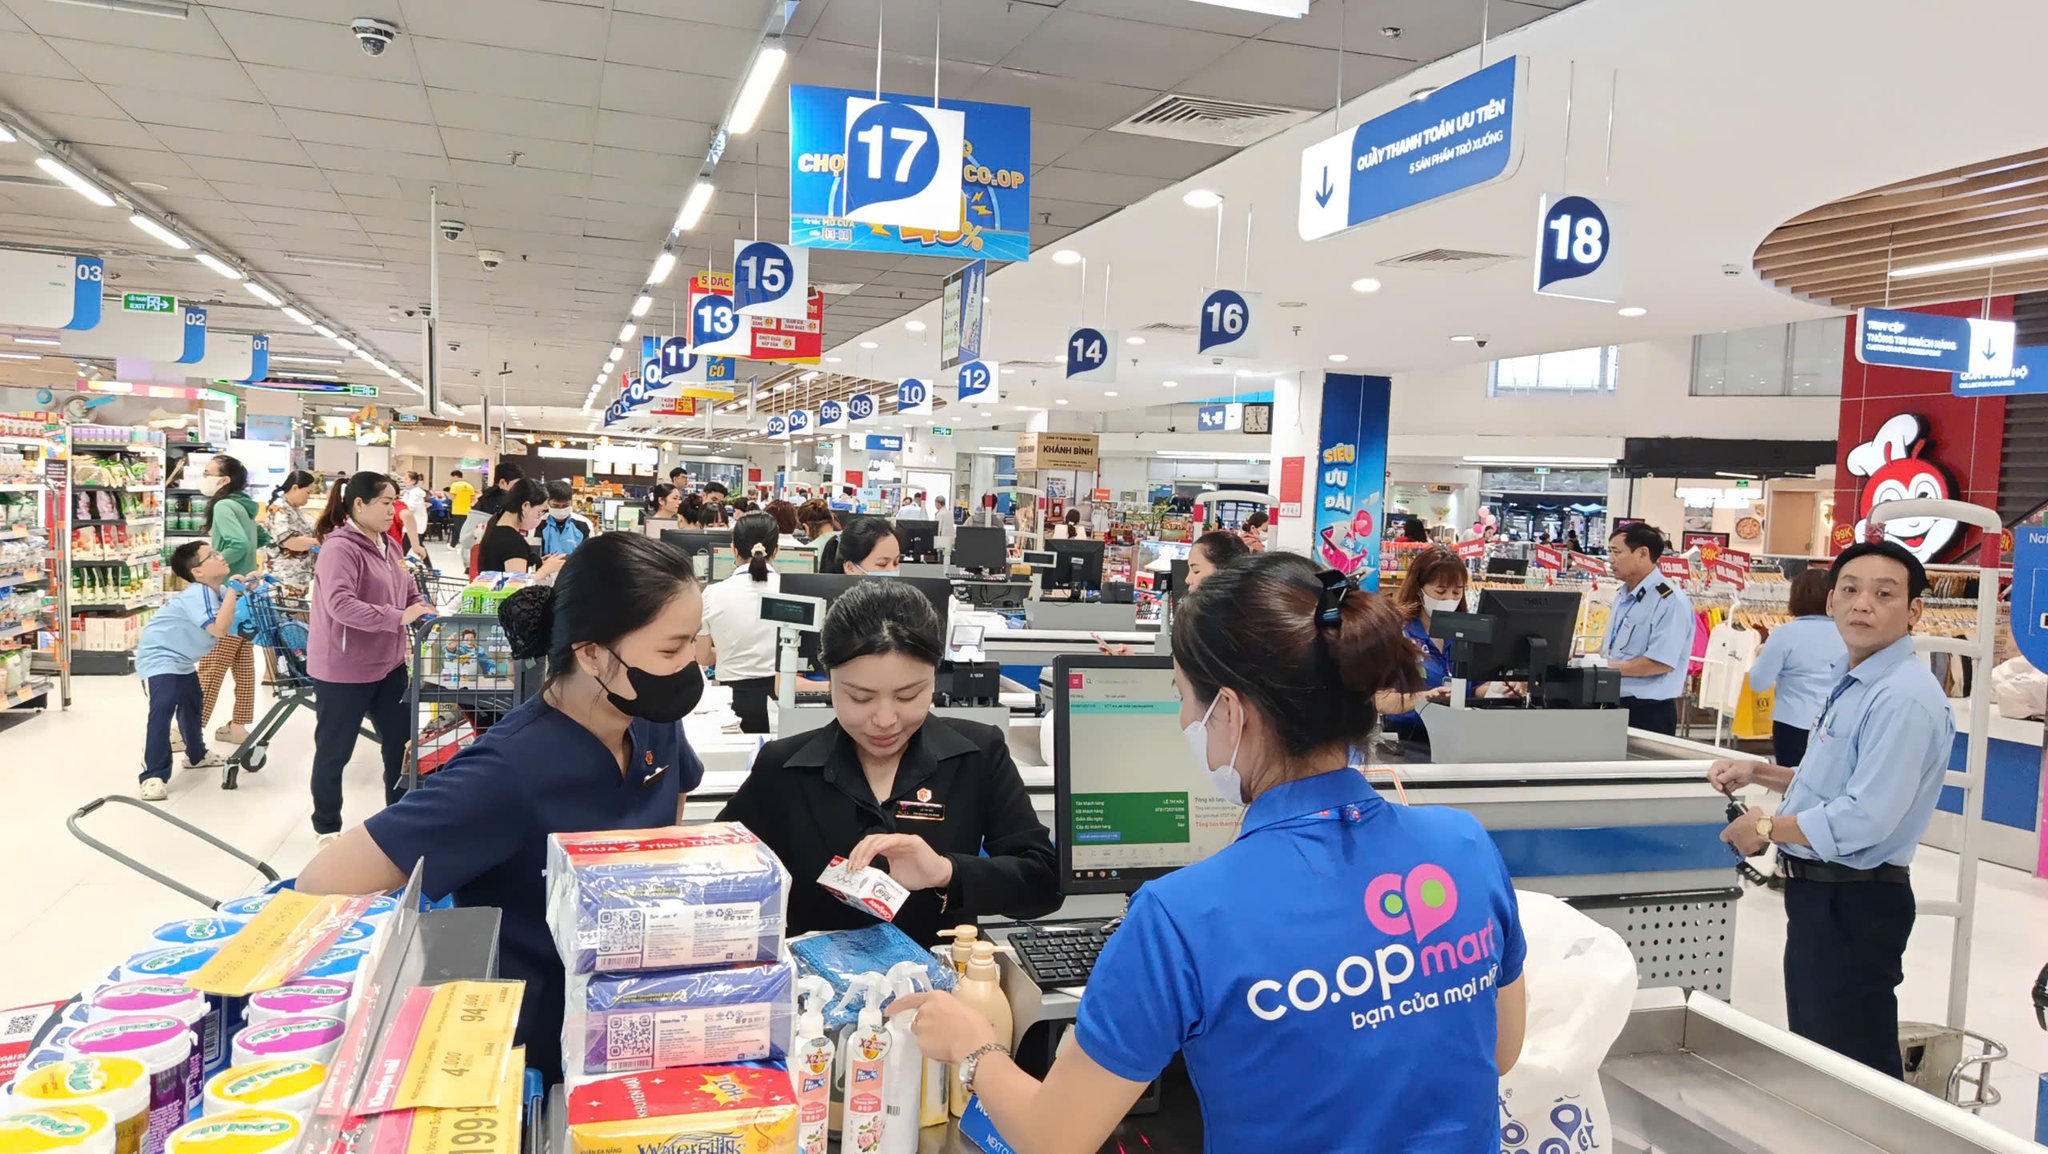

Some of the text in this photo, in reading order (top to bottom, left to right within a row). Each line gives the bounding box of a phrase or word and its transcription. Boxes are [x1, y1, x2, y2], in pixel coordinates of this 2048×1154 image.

[1356, 98, 1506, 172] QUẦY THANH TOÁN ƯU TIÊN
[857, 123, 928, 183] 17
[1408, 162, 1416, 175] 5
[1472, 128, 1504, 152] XUỐNG
[963, 164, 1025, 189] CO.OP
[1549, 215, 1603, 265] 18
[76, 264, 102, 282] 03
[701, 275, 708, 286] 5
[739, 256, 786, 293] 15
[185, 312, 206, 326] 02
[697, 305, 734, 335] 13
[1206, 303, 1244, 336] 16
[253, 339, 268, 351] 01
[1071, 340, 1103, 363] 14
[664, 344, 692, 368] 11
[645, 364, 661, 384] 0
[708, 362, 726, 378] CÓ
[961, 370, 987, 390] 12
[901, 385, 923, 402] 10
[852, 399, 871, 417] 08
[768, 419, 784, 433] 02
[789, 413, 807, 428] 04
[1043, 444, 1072, 455] KHÁNH
[1073, 445, 1093, 456] BÌNH
[1323, 442, 1355, 463] SIÊU
[1324, 467, 1348, 487] ƯU
[1324, 491, 1352, 514] ĐÃI
[578, 845, 619, 854] MUA
[624, 842, 641, 853] 2
[644, 840, 685, 851] TÍNH
[868, 899, 892, 920] Colgate
[1351, 1003, 1395, 1030] bạn
[1399, 991, 1440, 1014] của
[1444, 977, 1477, 1003] mọi
[119, 1020, 177, 1032] Cool
[282, 1018, 337, 1033] Cool
[858, 1038, 873, 1050] X2
[805, 1053, 819, 1064] X2
[257, 1062, 311, 1080] Cool
[712, 1075, 746, 1103] HOT
[228, 1121, 290, 1133] Cool
[985, 1133, 1004, 1154] NEXT
